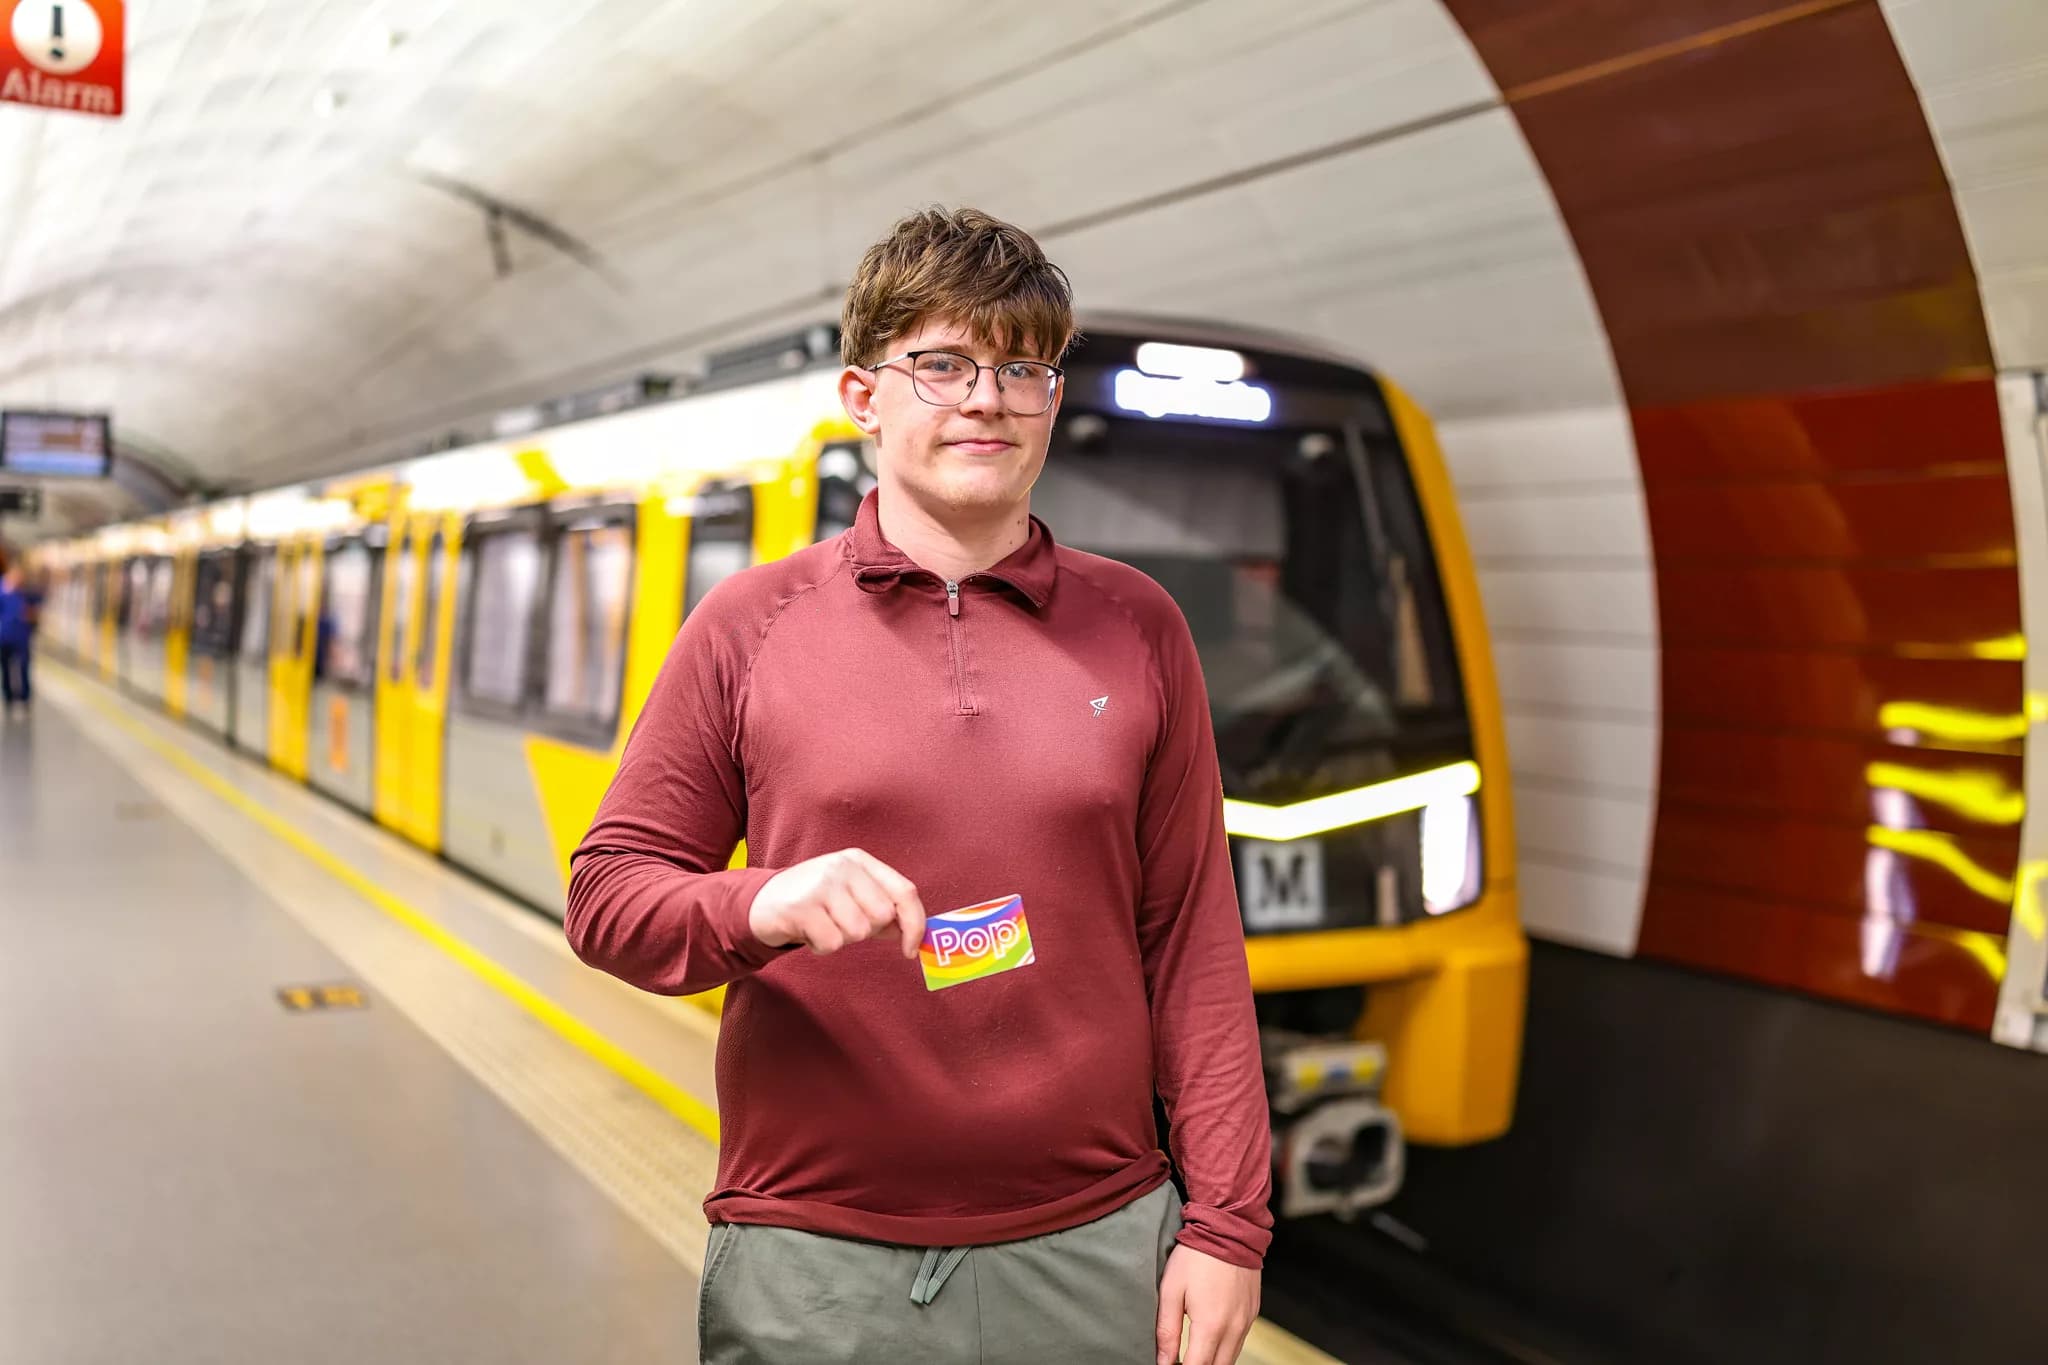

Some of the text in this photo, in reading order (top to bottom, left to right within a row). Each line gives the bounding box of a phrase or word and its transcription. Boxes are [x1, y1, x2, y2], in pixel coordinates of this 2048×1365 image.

[1, 68, 115, 113] Alarm
[1256, 853, 1308, 908] M
[931, 919, 1020, 967] Pop
